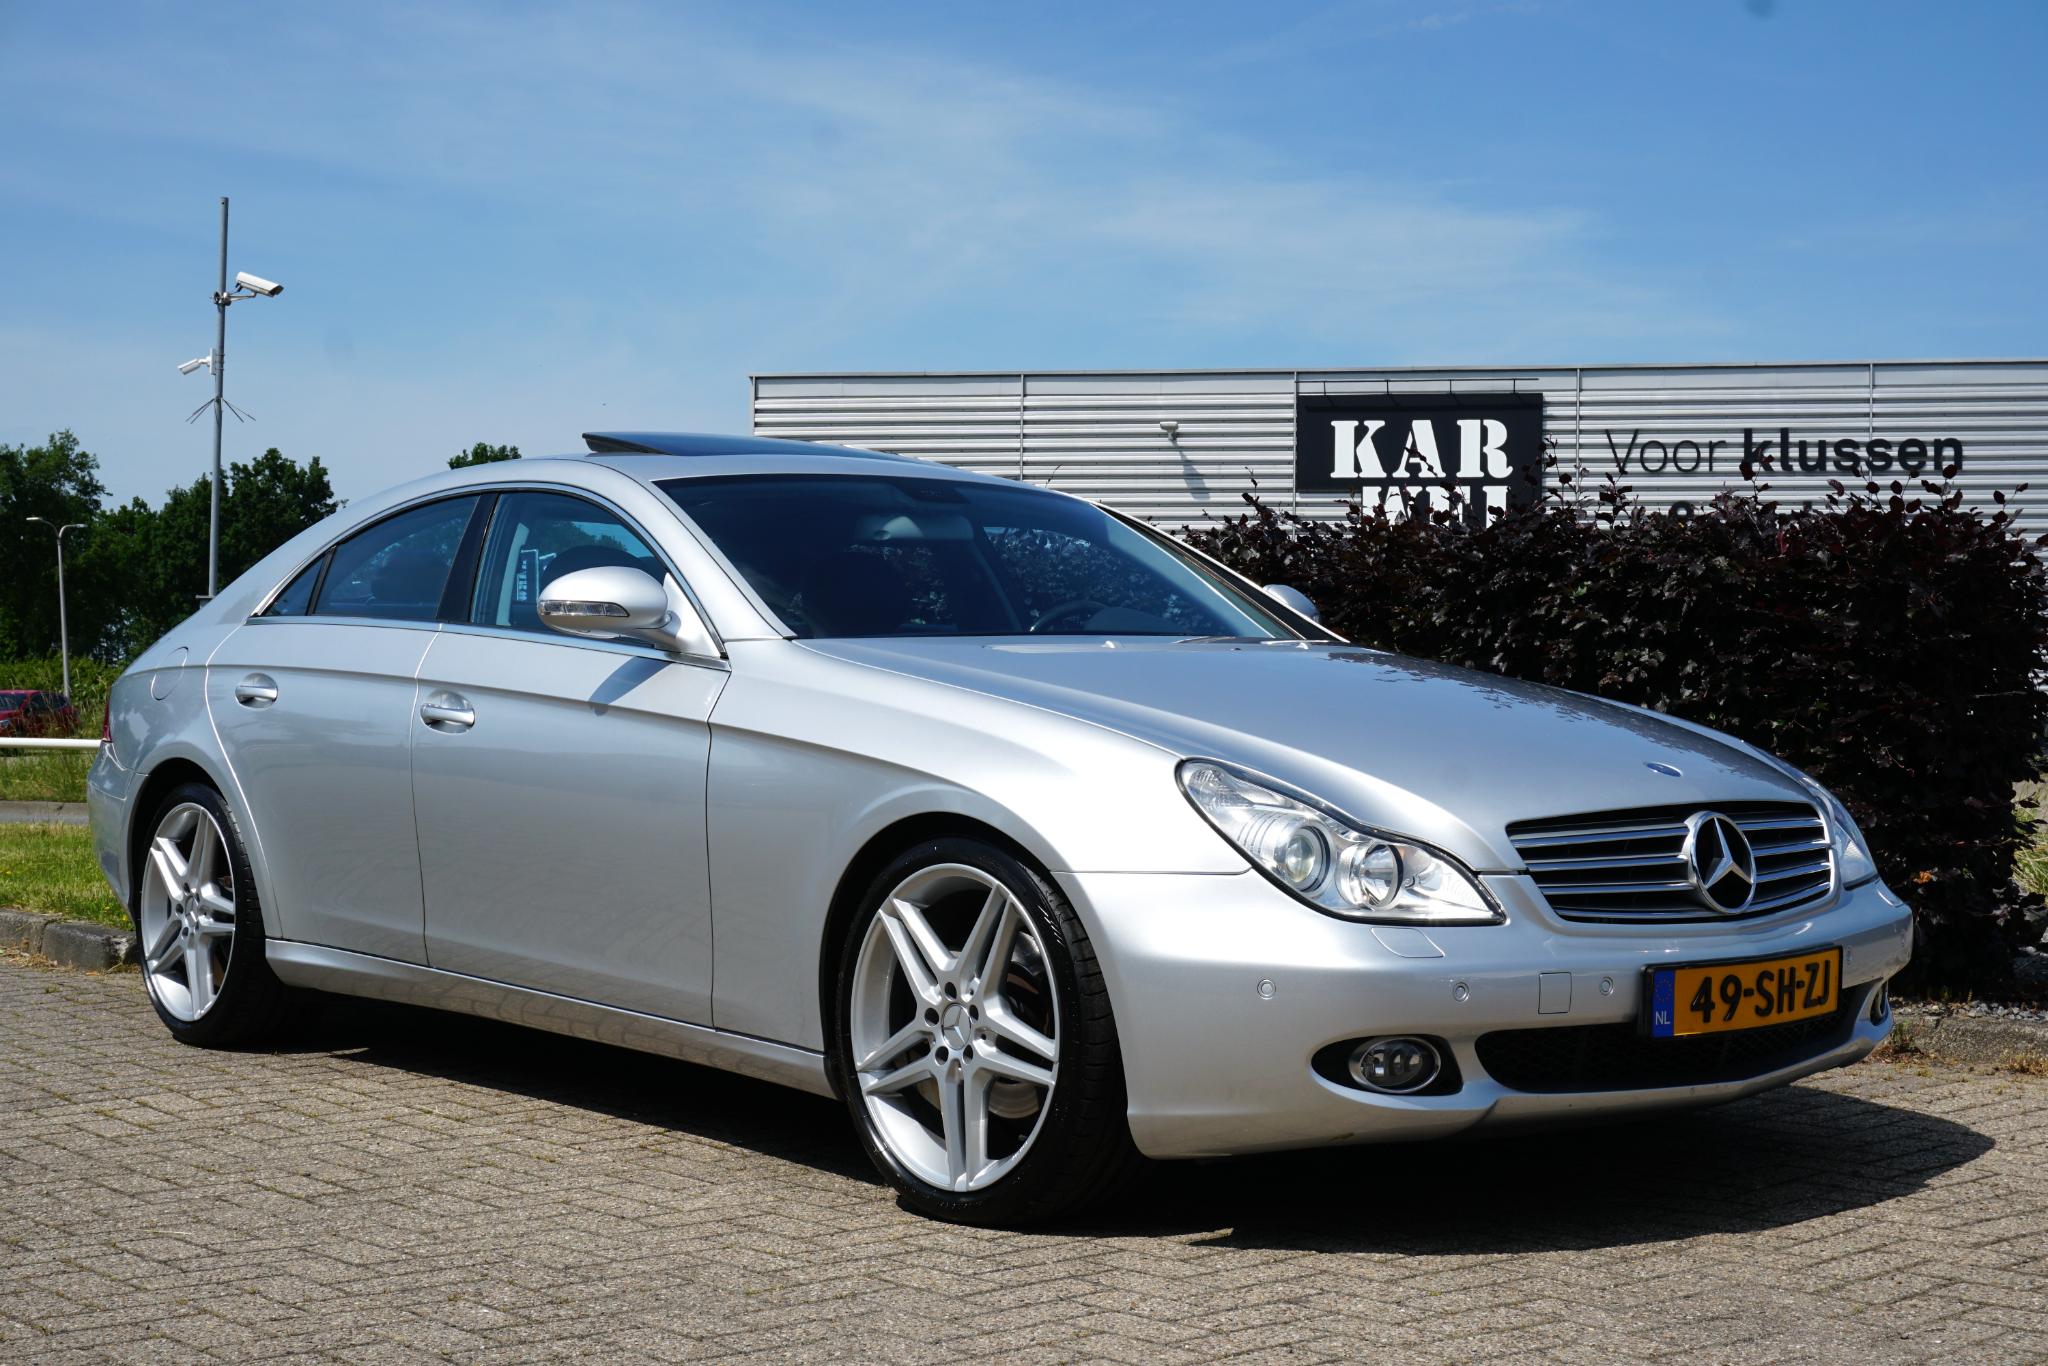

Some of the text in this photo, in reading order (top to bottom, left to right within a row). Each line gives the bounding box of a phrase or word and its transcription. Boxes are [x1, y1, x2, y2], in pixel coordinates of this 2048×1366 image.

[1330, 419, 1513, 478] KAR
[1604, 428, 1963, 473] Voor klussen
[1690, 959, 1831, 1023] 49-SH-ZJ
[1655, 1010, 1671, 1025] NL
